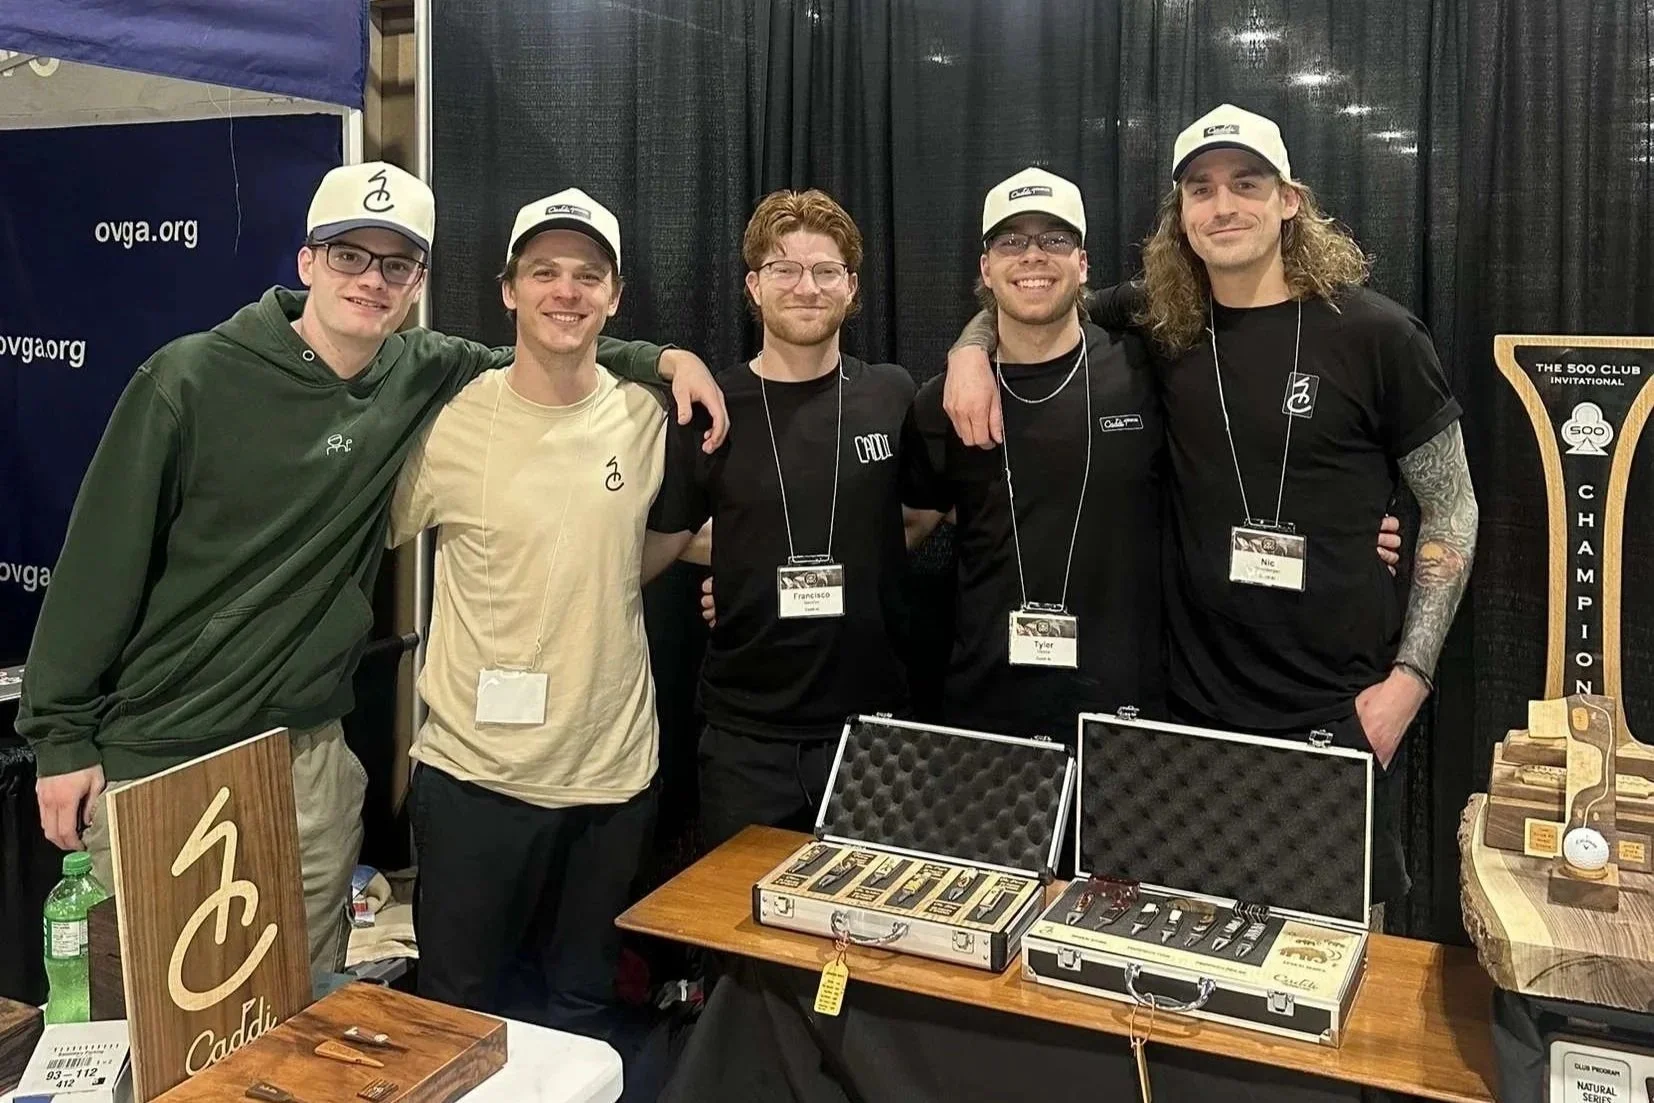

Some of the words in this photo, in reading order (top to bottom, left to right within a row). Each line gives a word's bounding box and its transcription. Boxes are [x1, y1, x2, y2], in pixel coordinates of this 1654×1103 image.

[94, 219, 198, 249] ovga.org
[1536, 363, 1563, 373] THE
[1567, 364, 1596, 374] 500
[1600, 364, 1641, 375] CLUB
[1550, 376, 1625, 386] INVITATIONAL
[1570, 426, 1605, 436] 500
[854, 433, 893, 463] CADDI
[1261, 558, 1275, 567] Nic
[793, 592, 831, 600] Francisco
[1575, 485, 1595, 695] CHAMPION
[1034, 640, 1054, 649] Tyler
[185, 996, 279, 1076] Caddi
[1574, 1063, 1590, 1071] CLUB
[1591, 1066, 1621, 1077] PROGRAM
[56, 1079, 75, 1088] 412
[1577, 1081, 1618, 1097] NATURAL
